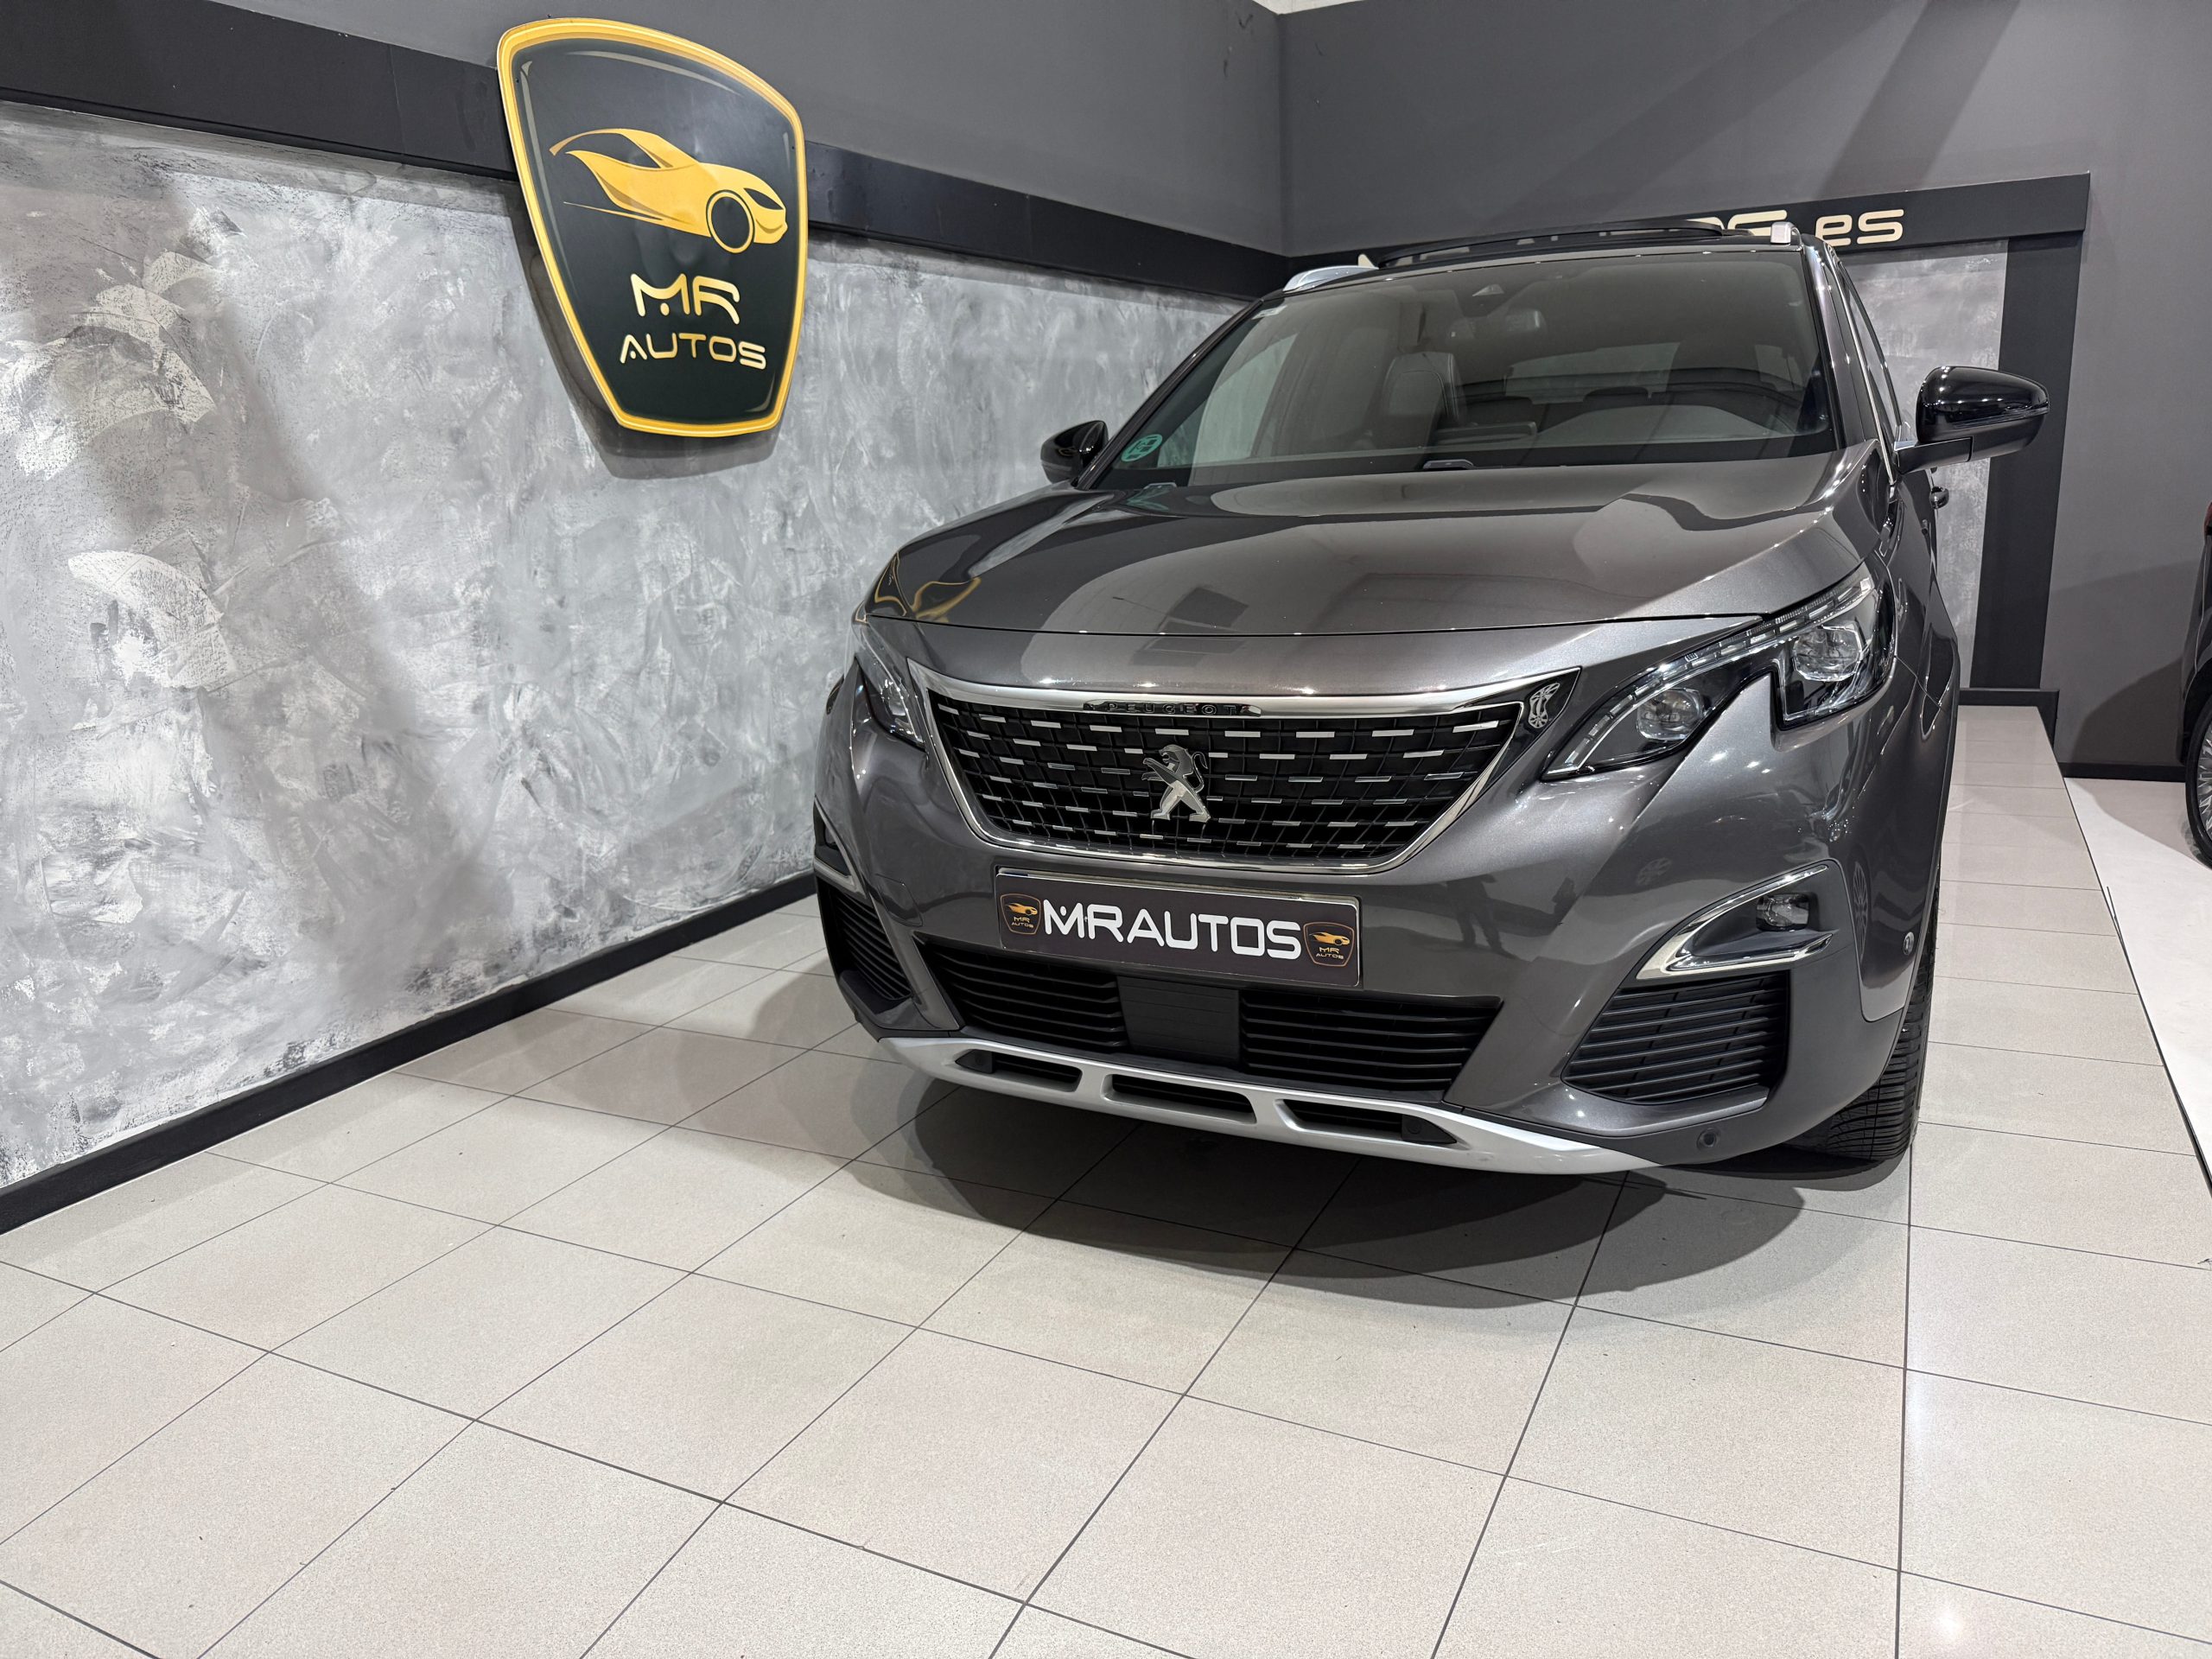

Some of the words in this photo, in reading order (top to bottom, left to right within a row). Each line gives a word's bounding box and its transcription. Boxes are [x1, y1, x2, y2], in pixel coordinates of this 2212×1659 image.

[630, 273, 741, 325] MR
[620, 333, 766, 370] AUTOS
[1106, 701, 1237, 716] PEUGEOT
[1043, 899, 1301, 960] MRAUTOS
